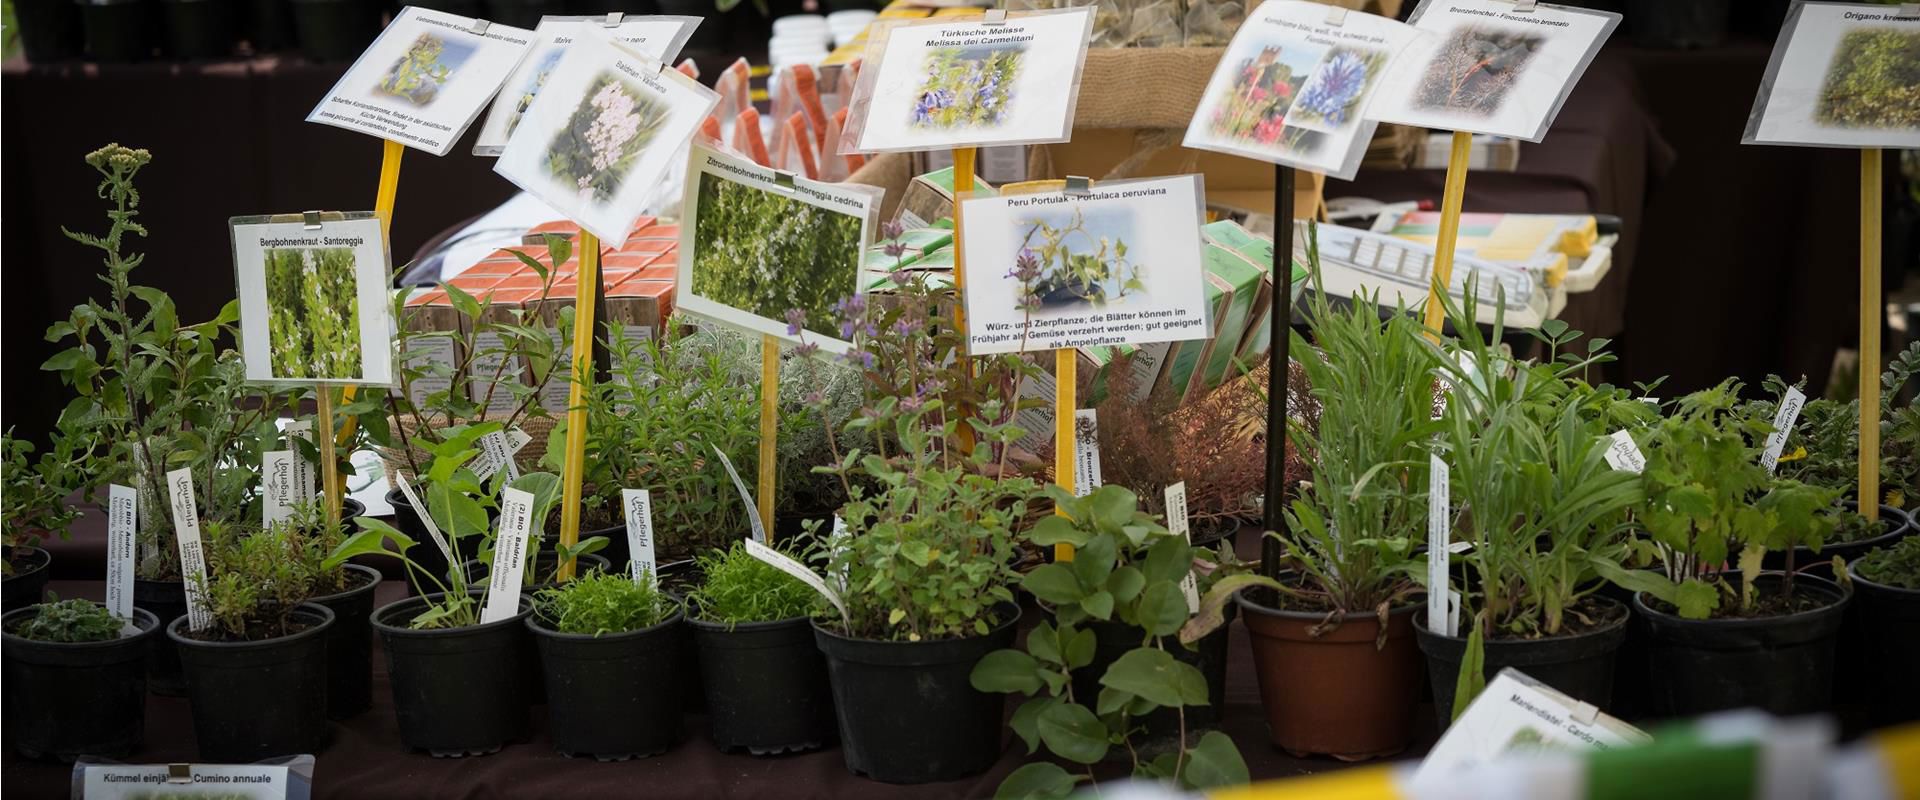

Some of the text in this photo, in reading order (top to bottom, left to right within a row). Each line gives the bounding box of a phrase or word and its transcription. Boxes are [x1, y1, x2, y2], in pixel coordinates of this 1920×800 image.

[1450, 6, 1496, 17] Bronzefenchel
[1540, 19, 1569, 27] bronzato
[1844, 11, 1881, 21] Origano
[926, 39, 961, 47] Melissa
[980, 34, 1034, 44] Carmelitani
[940, 26, 1025, 37] Türkische Melisse
[615, 59, 639, 78] Baldrian
[794, 184, 832, 201] antoreggia
[833, 195, 864, 209] cedrina
[1007, 199, 1029, 207] Peru
[1031, 195, 1069, 205] Portulak
[1076, 192, 1120, 202] Portulaca
[1122, 187, 1167, 198] peruviana
[260, 237, 318, 248] Bergbohnenkraut
[323, 236, 364, 247] Santoreggia
[986, 322, 1013, 331] Würz-
[1035, 316, 1087, 329] Zierpflanze;
[1090, 314, 1104, 323] die
[1106, 312, 1136, 322] Blätter
[1139, 309, 1172, 320] können
[1175, 308, 1186, 316] im
[972, 333, 1010, 344] Frühjahr
[1028, 329, 1066, 340] Gemüse
[1068, 326, 1105, 336] verzehrt
[1107, 323, 1144, 333] werden;
[1148, 321, 1161, 332] gut
[1163, 317, 1202, 330] geeignet
[1050, 335, 1126, 349] als Ampelpflanze
[1775, 400, 1799, 446] Pflegerhof
[279, 462, 290, 507] Pflegerhof
[180, 480, 194, 528] Pflegerhof
[518, 503, 526, 514] (2)
[516, 516, 525, 531] BIO
[636, 500, 648, 547] Pflegerhof
[510, 536, 522, 569] Baldrian
[1510, 694, 1563, 728] Mariendistel
[1567, 724, 1594, 743] Cardo
[104, 773, 141, 782] Kümmel
[194, 775, 229, 783] Cumino
[232, 775, 271, 783] annuale
